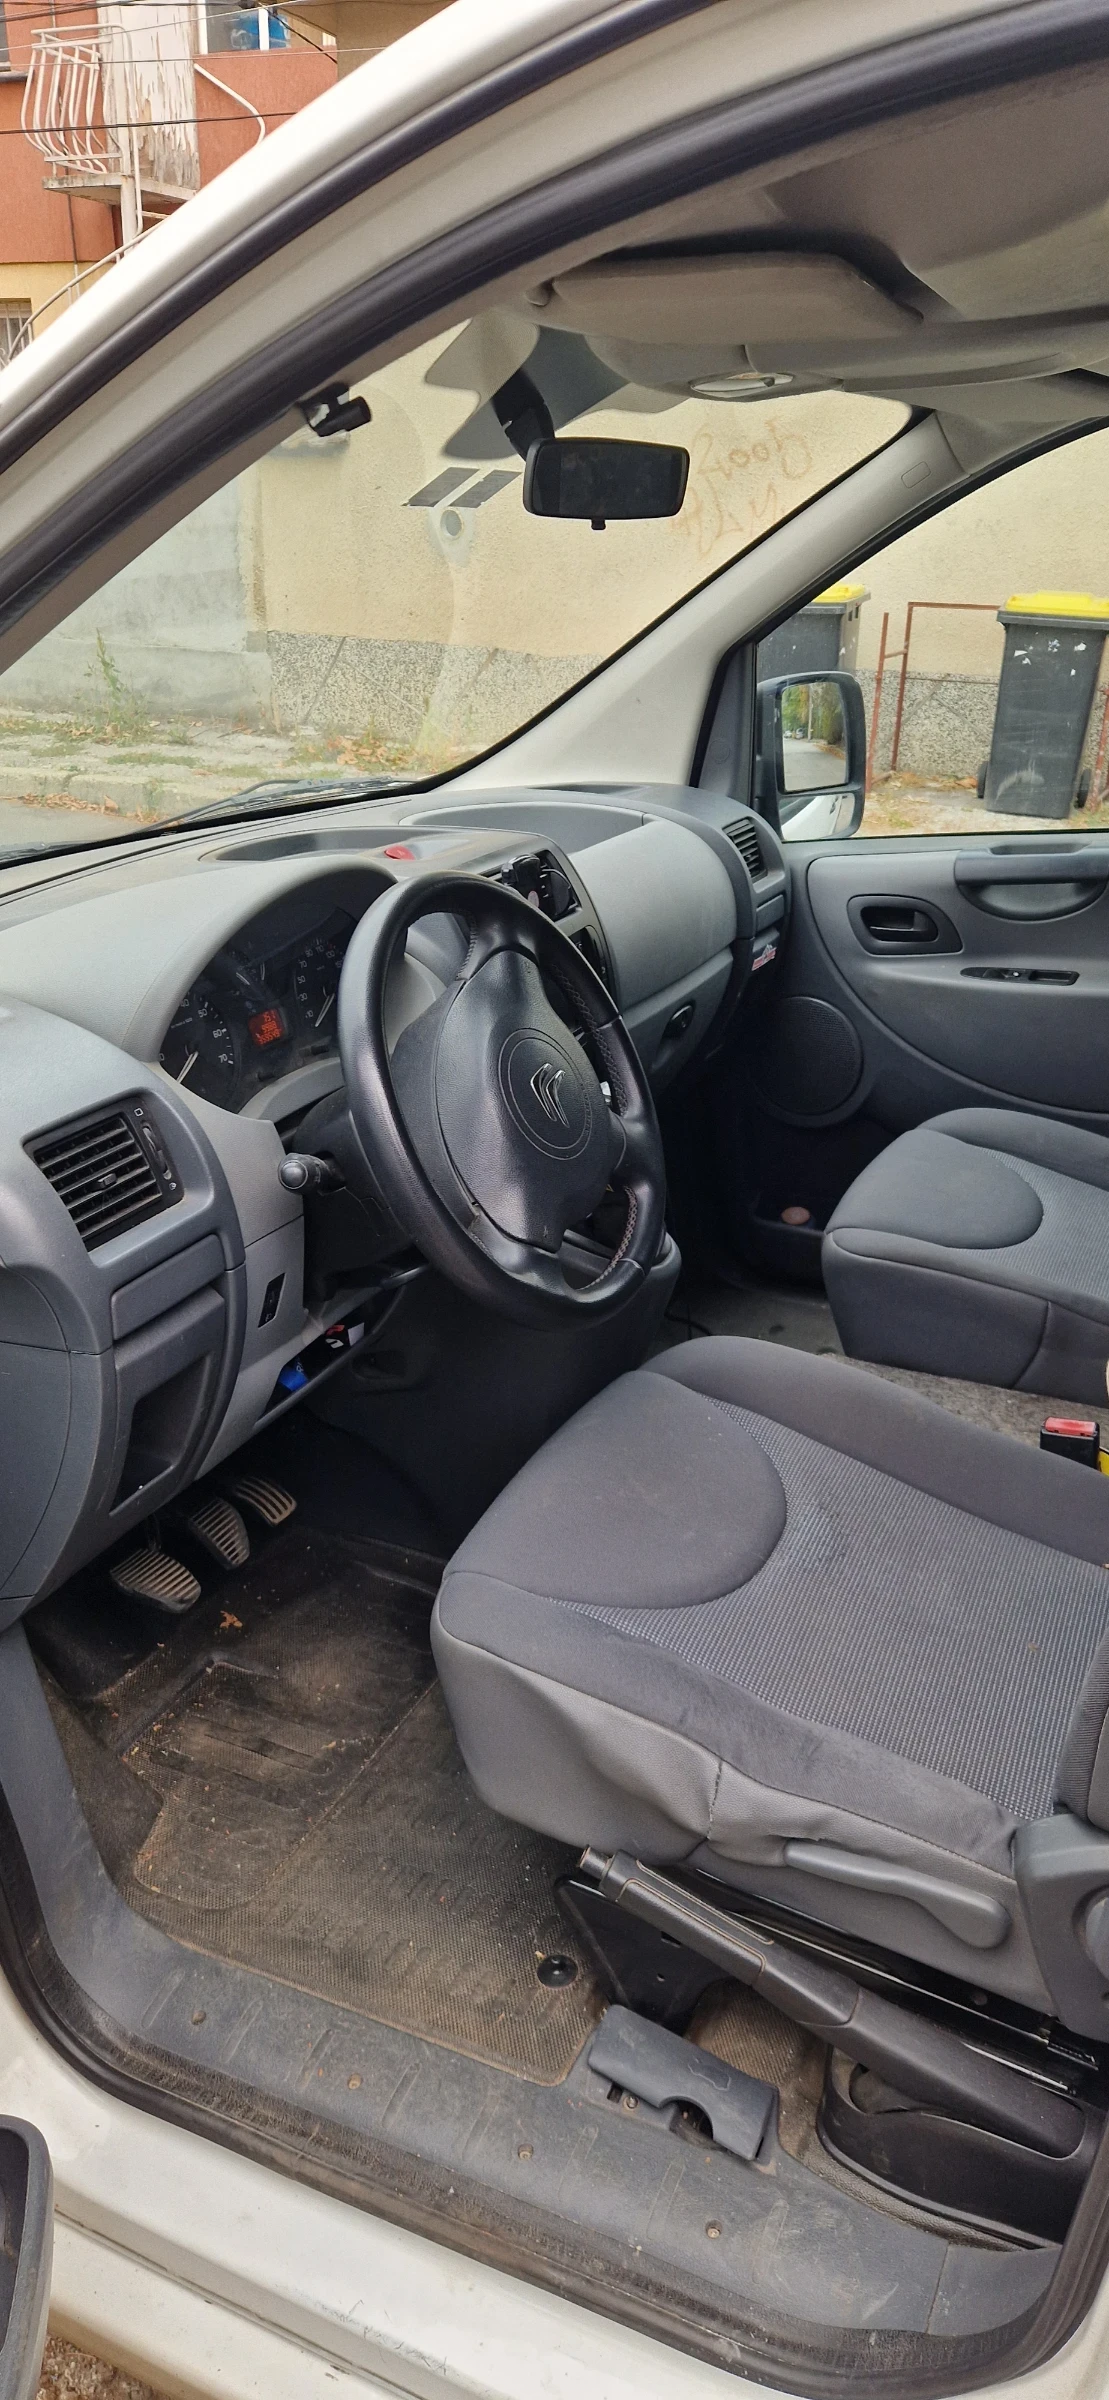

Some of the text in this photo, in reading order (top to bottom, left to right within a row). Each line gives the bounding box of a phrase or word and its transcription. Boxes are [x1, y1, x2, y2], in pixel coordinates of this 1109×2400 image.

[297, 975, 305, 984] 50
[299, 993, 307, 1001] 30
[198, 1009, 207, 1017] 50
[213, 1029, 222, 1038] 60
[218, 1054, 227, 1063] 70
